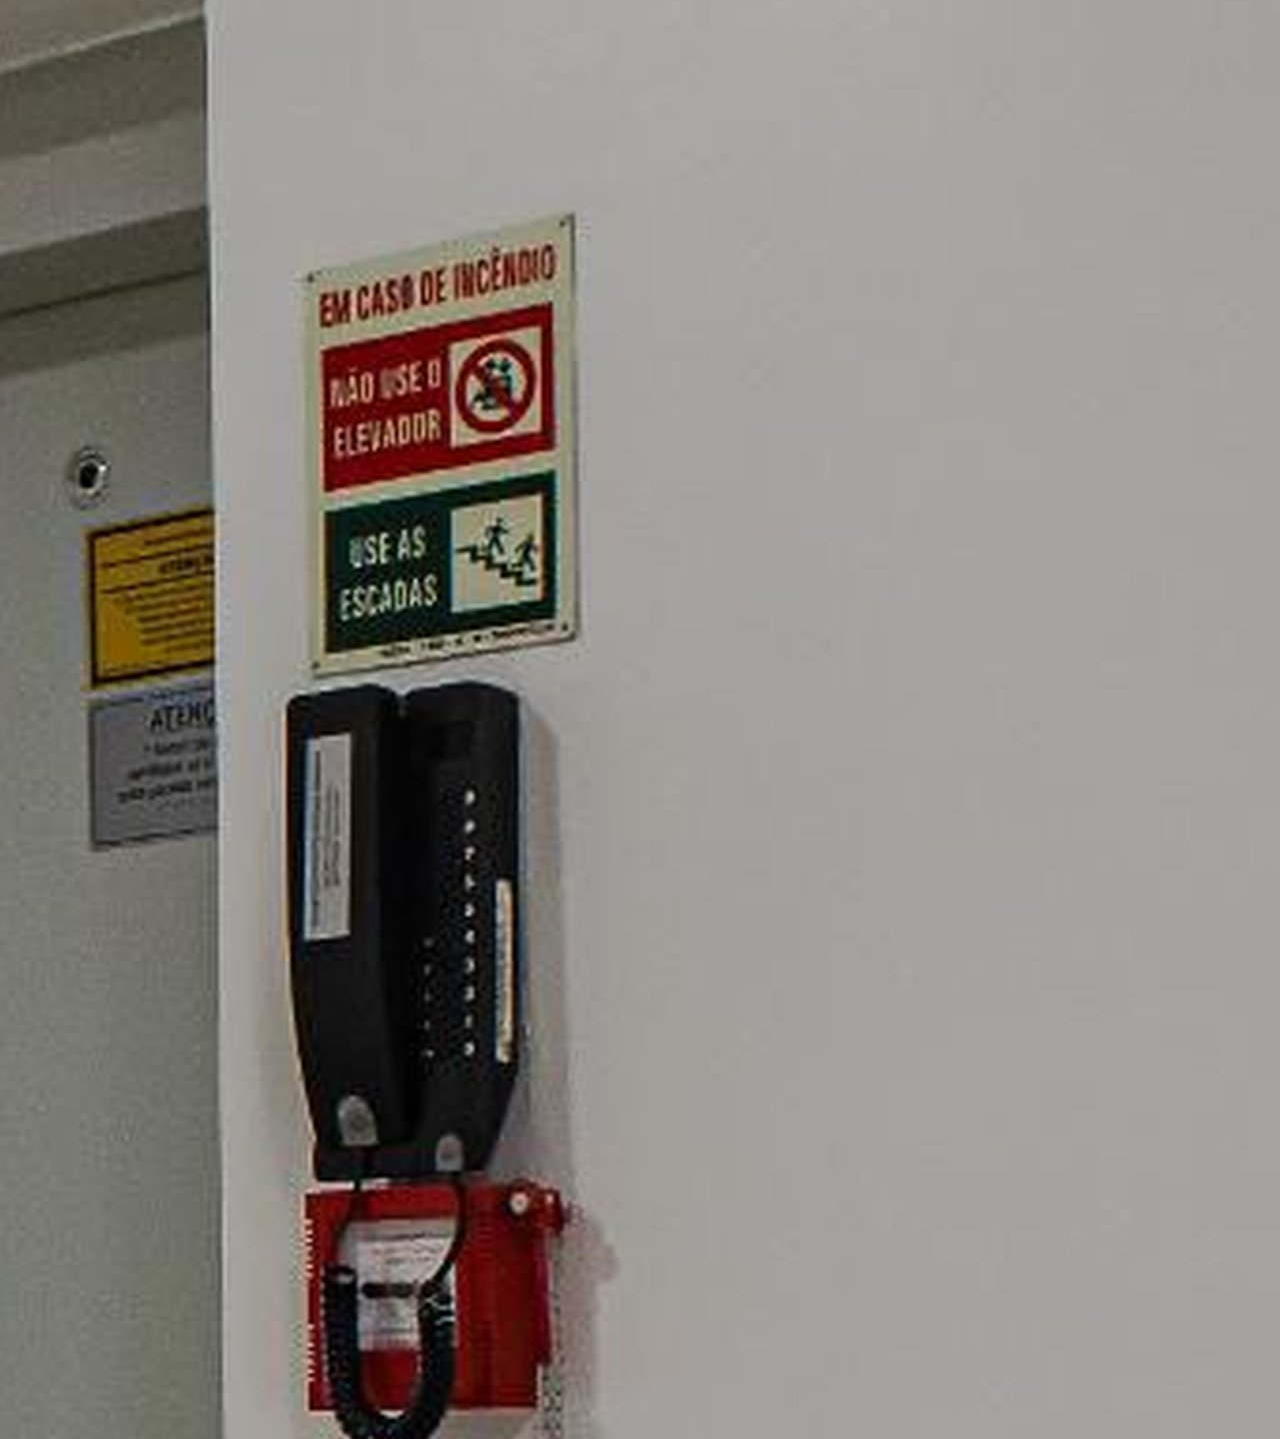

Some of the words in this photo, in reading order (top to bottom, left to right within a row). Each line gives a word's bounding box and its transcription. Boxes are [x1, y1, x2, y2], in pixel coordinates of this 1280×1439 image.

[320, 287, 351, 328] EM
[356, 274, 416, 321] CASO
[420, 266, 447, 306] DE
[454, 244, 557, 301] INCÊNDIO
[329, 368, 374, 408] NÃO
[379, 361, 422, 400] USE
[427, 358, 441, 389] O
[333, 408, 441, 459] ELEVADOR
[348, 532, 391, 569] USE
[397, 525, 427, 561] AS
[340, 573, 439, 622] ESCADAS
